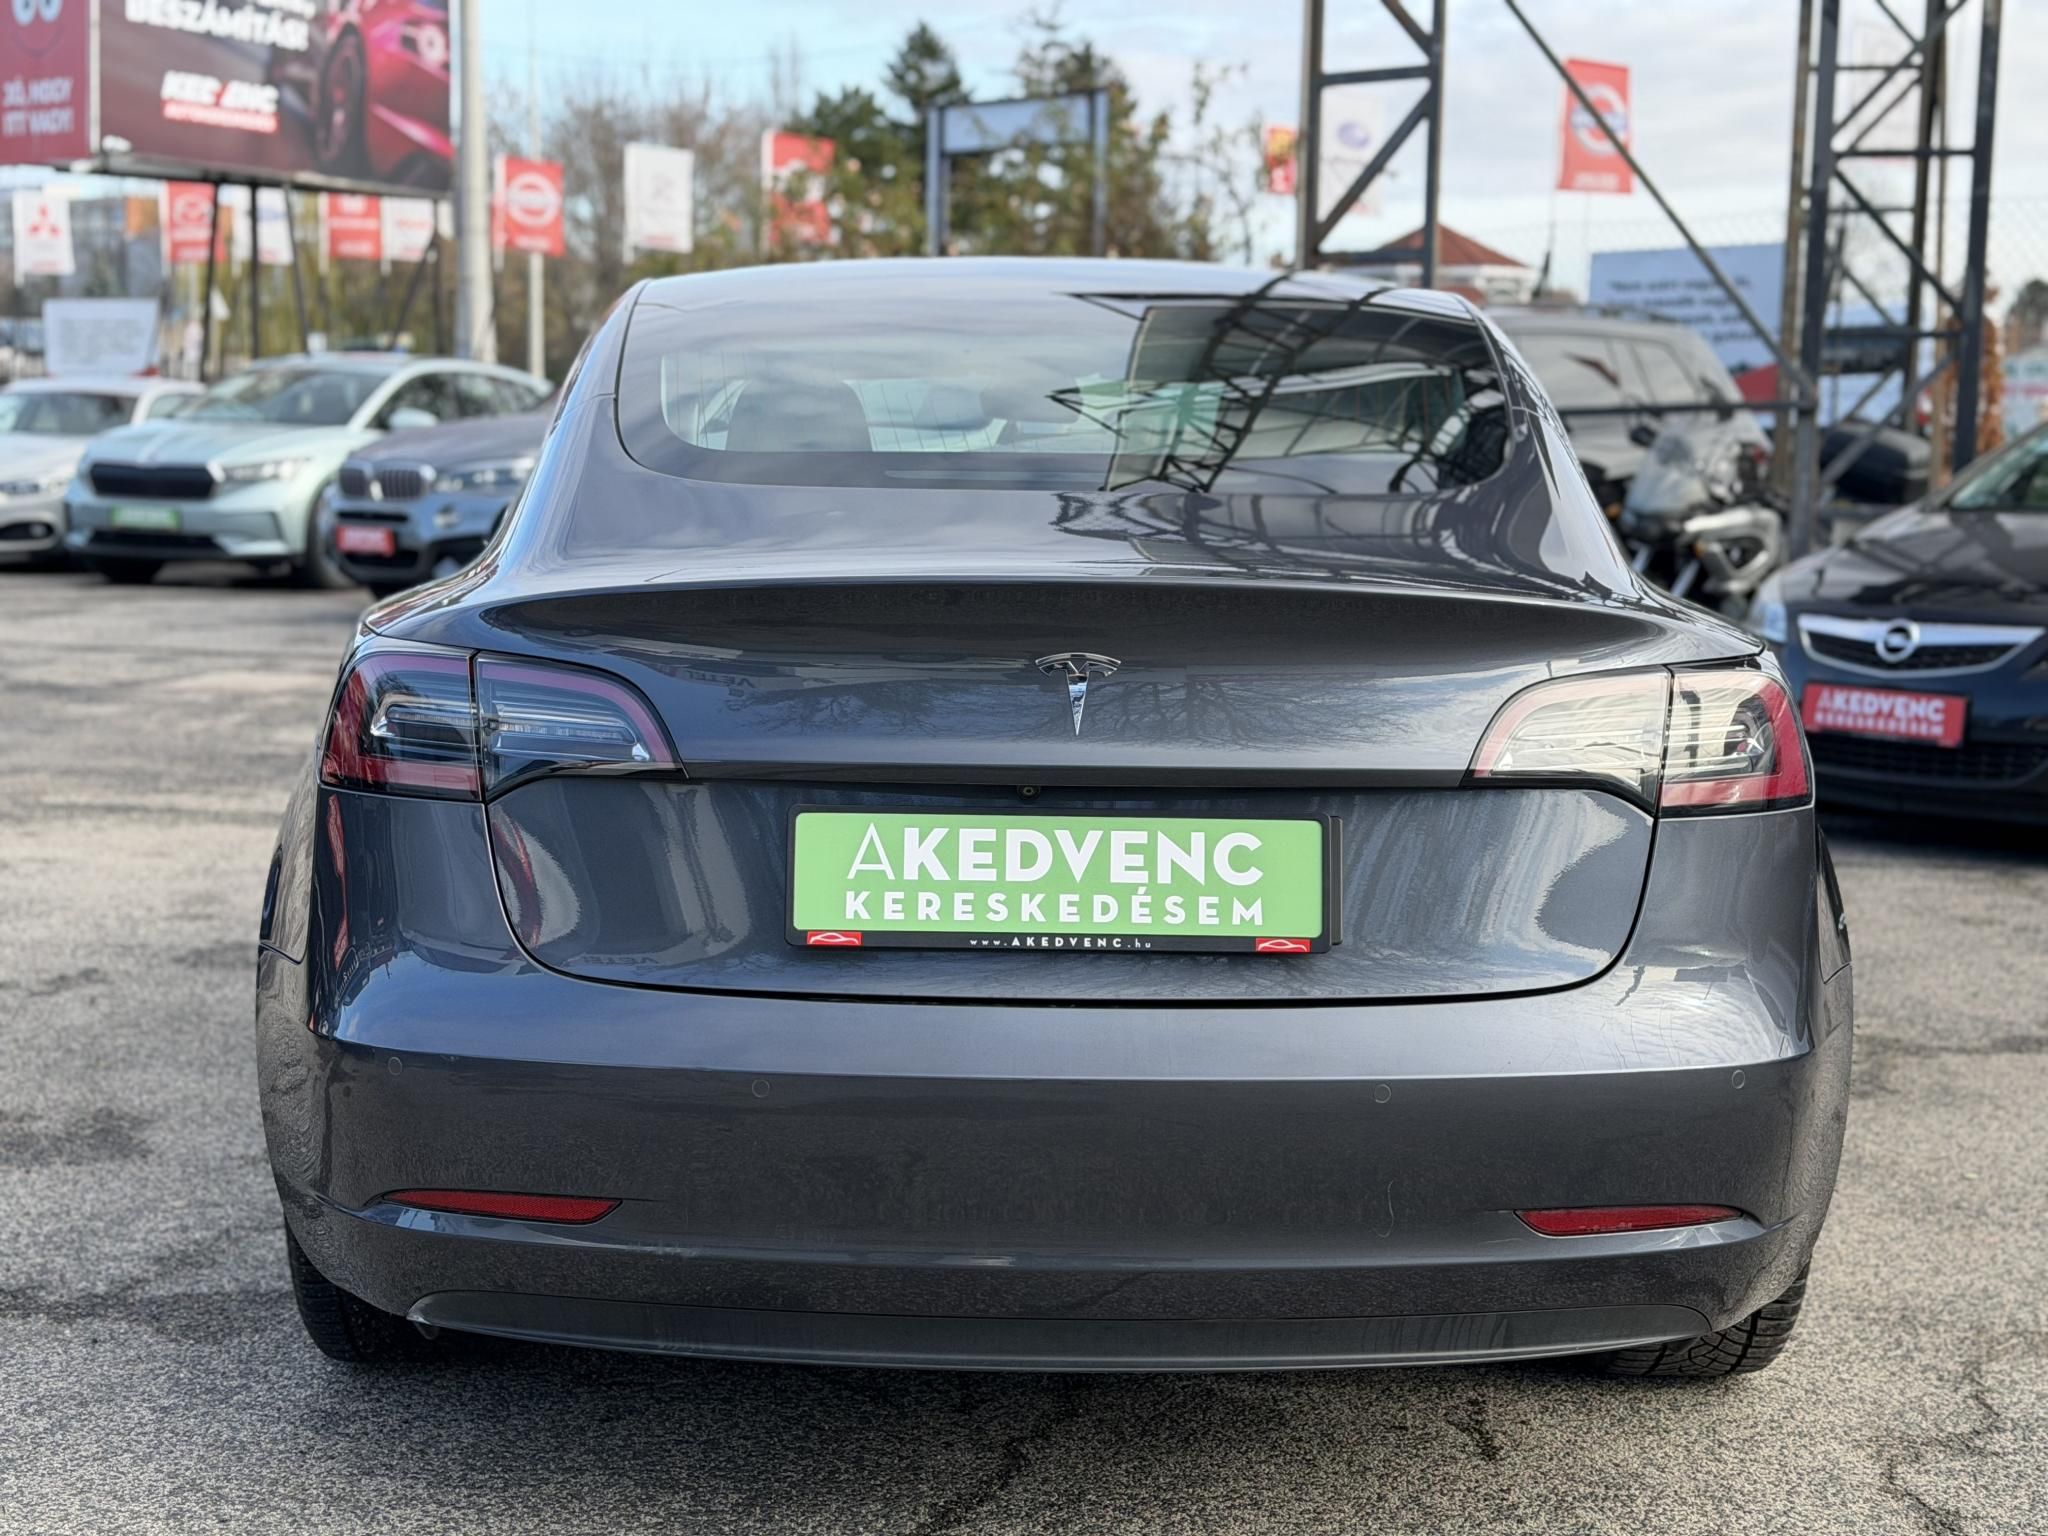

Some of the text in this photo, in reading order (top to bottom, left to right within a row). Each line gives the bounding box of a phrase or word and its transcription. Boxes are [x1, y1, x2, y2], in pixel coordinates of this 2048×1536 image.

[1815, 687, 1946, 722] AKEDVENC
[847, 822, 1264, 886] AKEDVENC
[845, 886, 1264, 926] KERESKEDÉSEM
[969, 936, 1152, 949] www.AKEDVENC.hu
